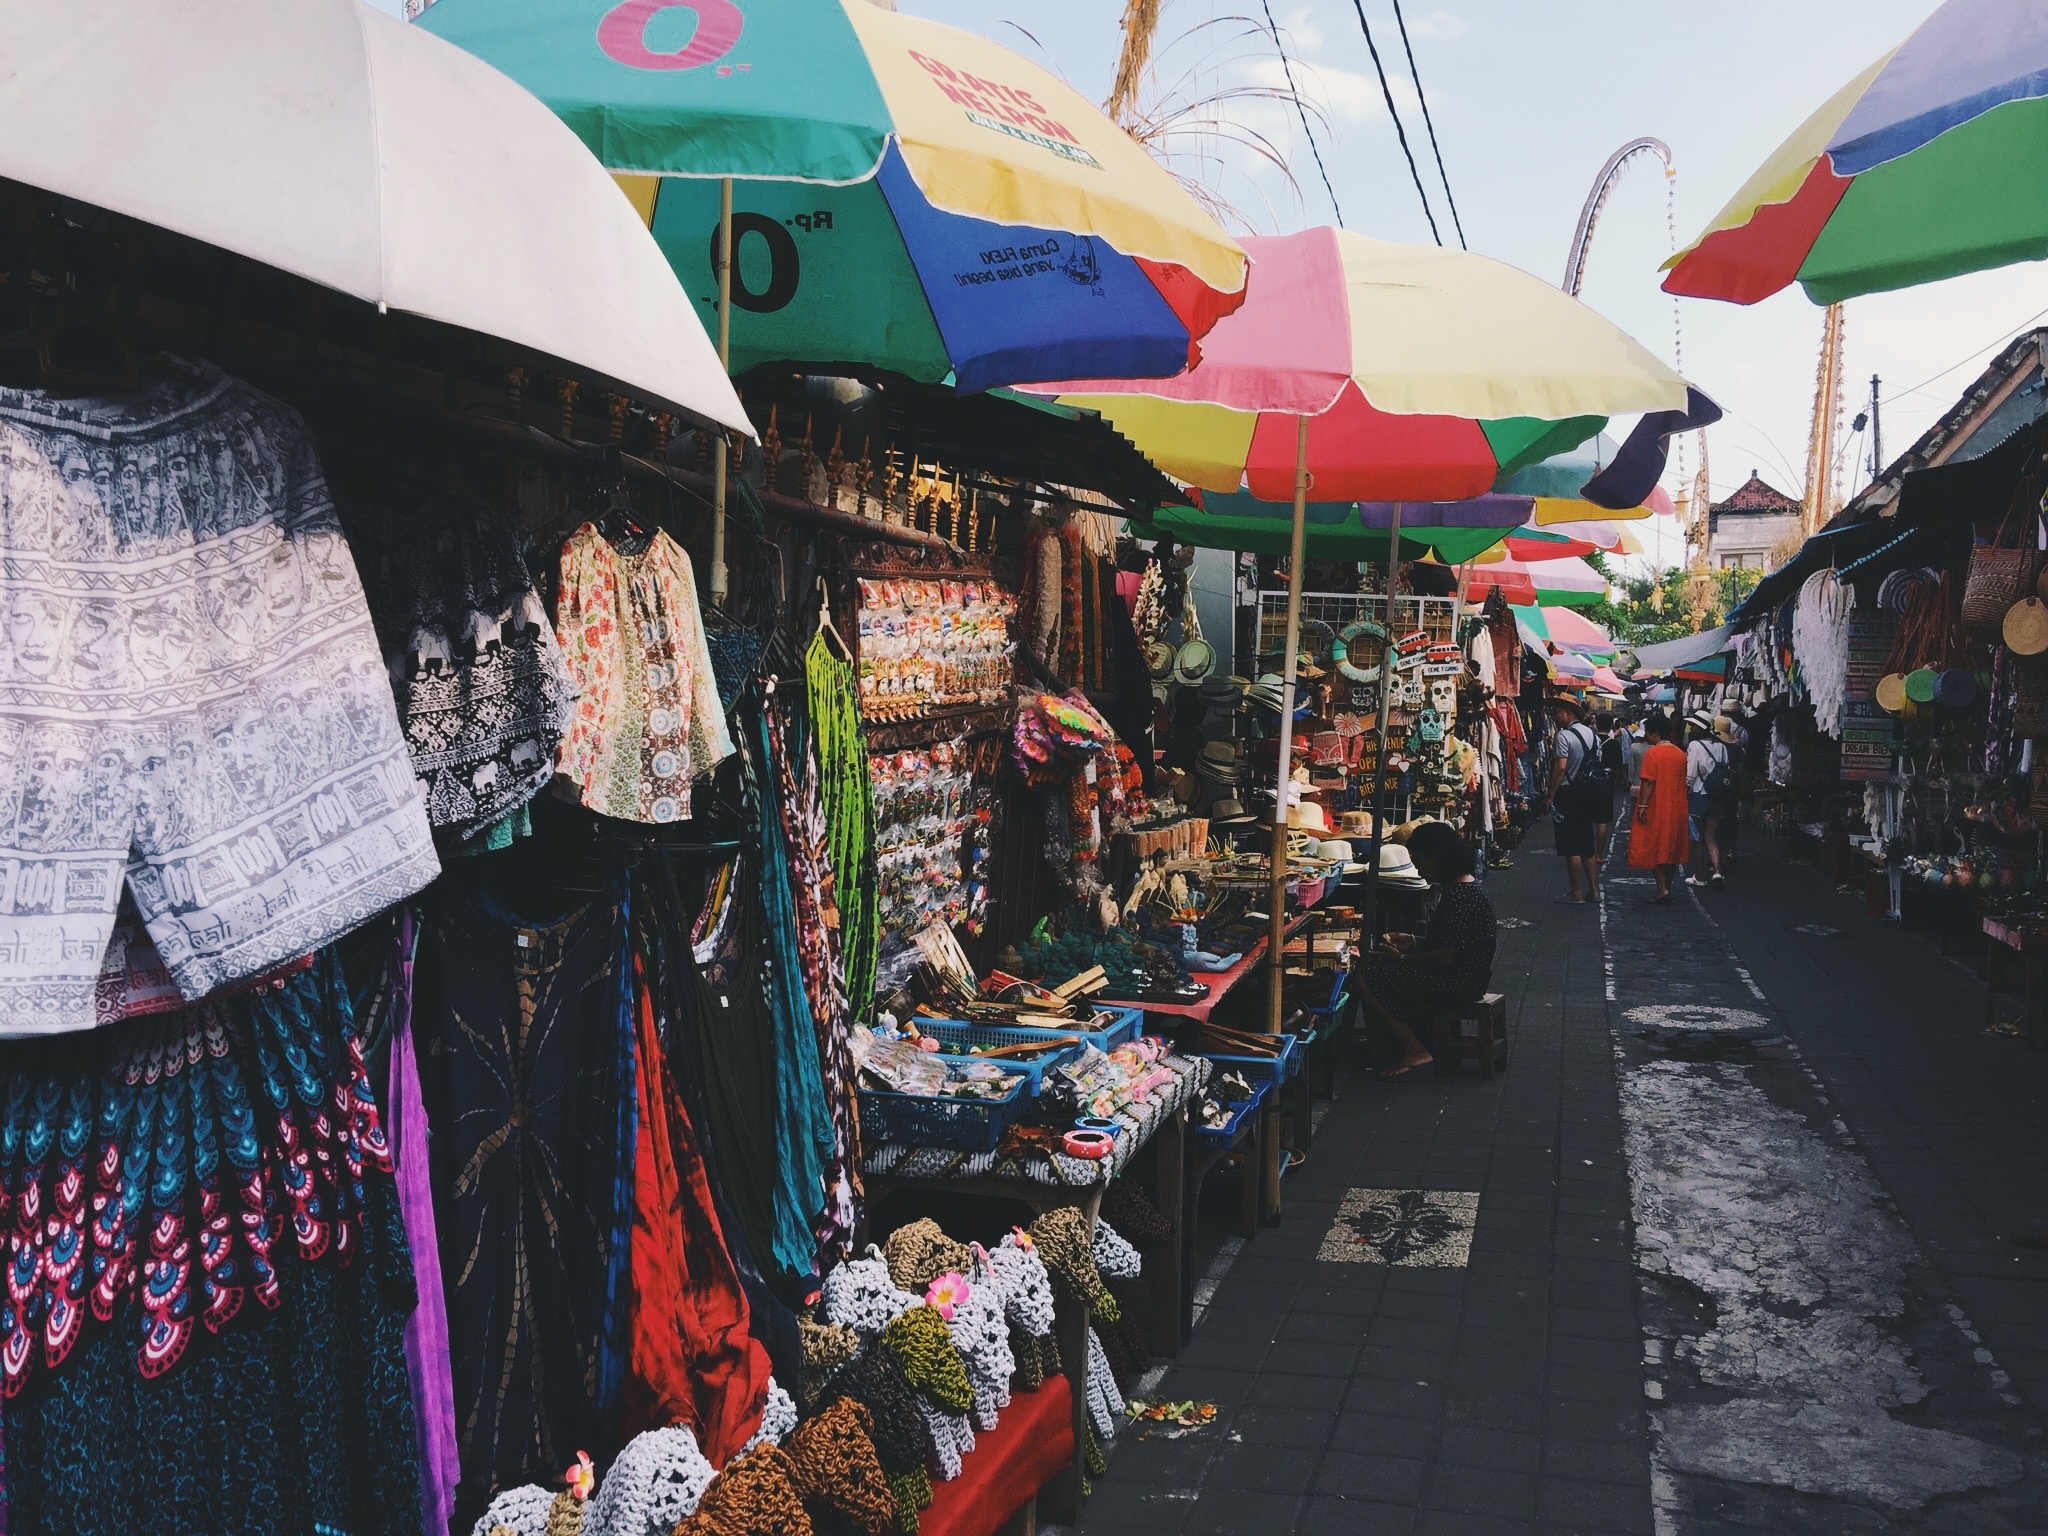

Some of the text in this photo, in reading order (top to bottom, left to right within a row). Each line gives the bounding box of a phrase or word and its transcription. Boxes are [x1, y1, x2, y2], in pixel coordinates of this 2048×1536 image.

[907, 49, 1046, 114] GRATIS
[931, 76, 1081, 145] NELPON
[1365, 736, 1406, 753] BIEENUE
[1845, 743, 1888, 755] DREAM BIG
[1358, 757, 1377, 770] OPE
[1359, 777, 1399, 797] BIENNUE
[178, 913, 232, 950] bali
[257, 878, 301, 920] bali
[315, 844, 369, 886] bali
[382, 812, 424, 852] bali
[0, 929, 27, 965] ali
